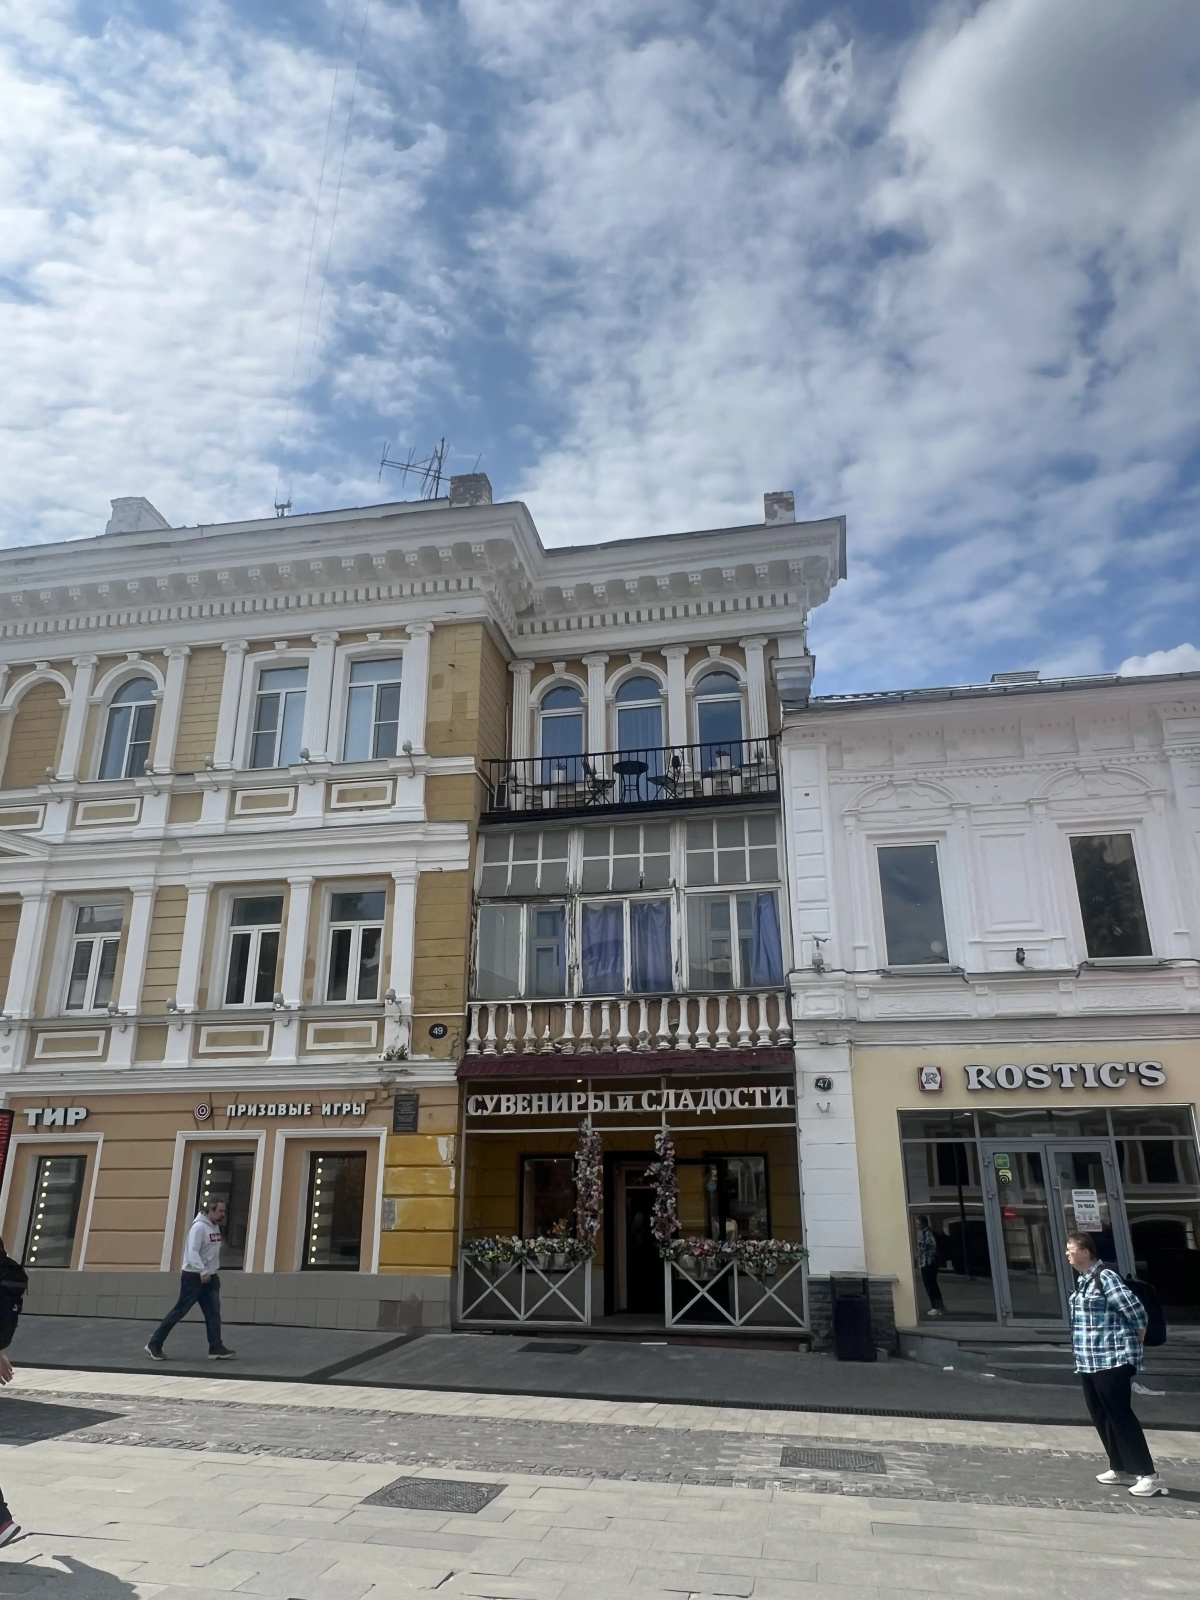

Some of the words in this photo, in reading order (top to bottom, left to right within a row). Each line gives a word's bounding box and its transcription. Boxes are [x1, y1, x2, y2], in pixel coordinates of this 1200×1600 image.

[432, 1026, 444, 1035] 49
[923, 1071, 939, 1085] R
[964, 1061, 1167, 1090] ROSTIC'S
[817, 1079, 829, 1088] 47
[467, 1091, 611, 1116] СУВЕНИРЫ
[616, 1096, 634, 1112] и
[641, 1086, 790, 1115] СЛАДОСТИ
[23, 1107, 88, 1126] ТИР
[226, 1103, 312, 1117] ПРИЗОВЫЕ
[321, 1102, 367, 1116] ИГРЫ
